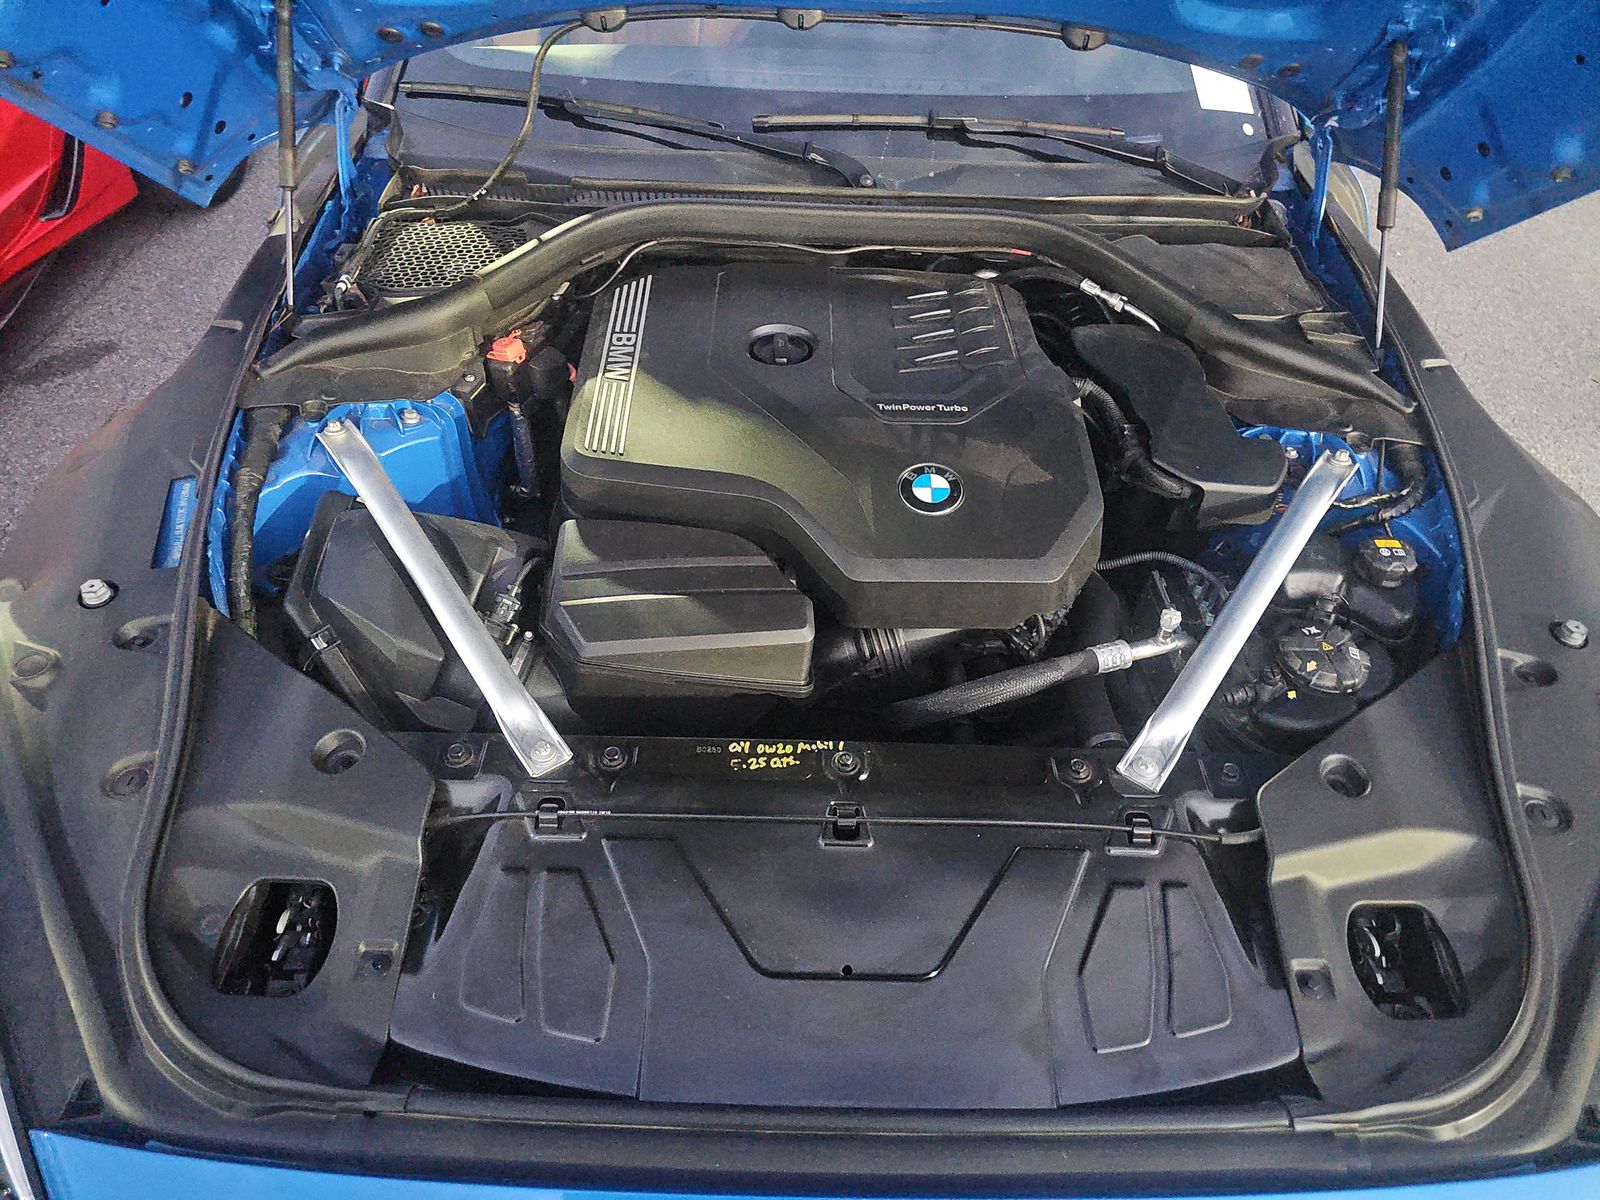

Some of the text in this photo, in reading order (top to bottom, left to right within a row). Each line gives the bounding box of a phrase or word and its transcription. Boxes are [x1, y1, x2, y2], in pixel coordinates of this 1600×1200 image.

[604, 333, 637, 382] BMW
[937, 404, 969, 412] Turbo
[906, 466, 957, 482] BMW
